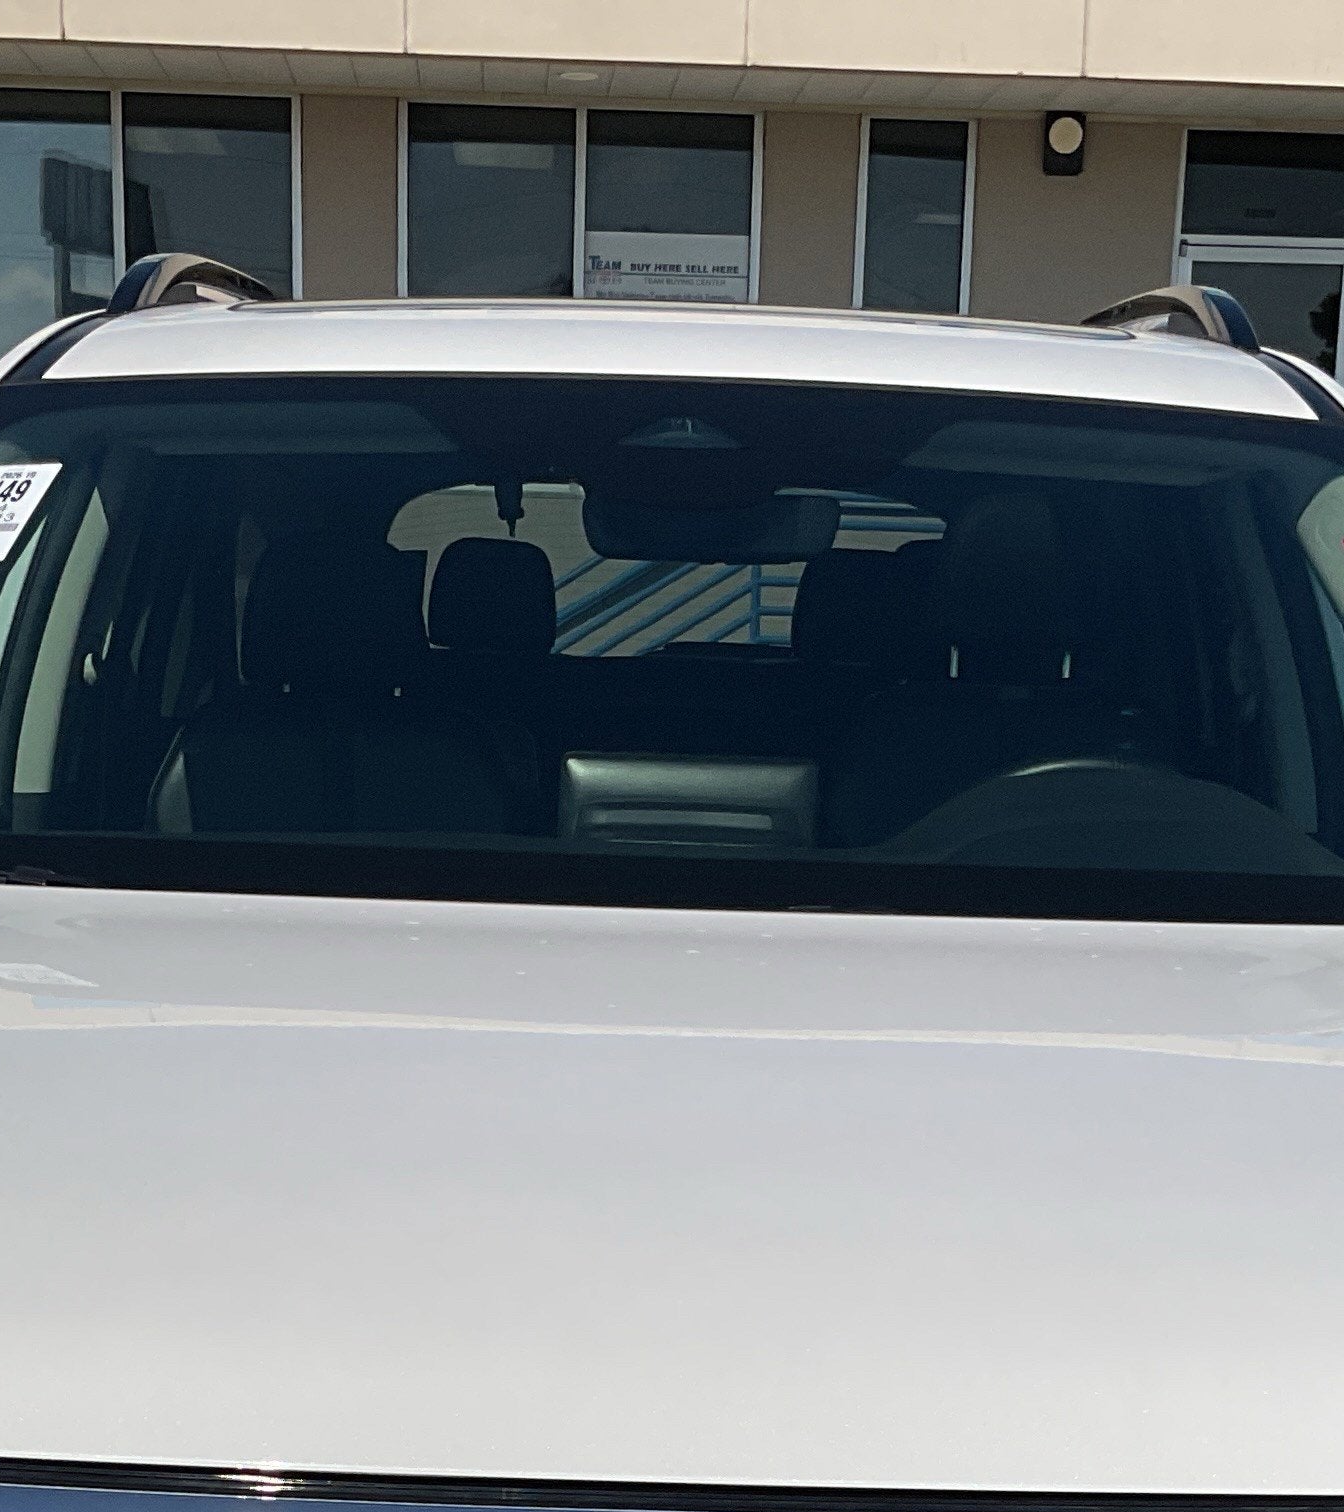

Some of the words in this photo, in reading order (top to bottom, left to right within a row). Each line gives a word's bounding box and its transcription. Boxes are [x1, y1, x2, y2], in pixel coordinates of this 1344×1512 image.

[630, 262, 651, 272] BUY
[654, 263, 682, 273] HERE
[685, 264, 709, 274] SELL
[712, 265, 740, 274] HERE
[696, 279, 726, 287] CENTER
